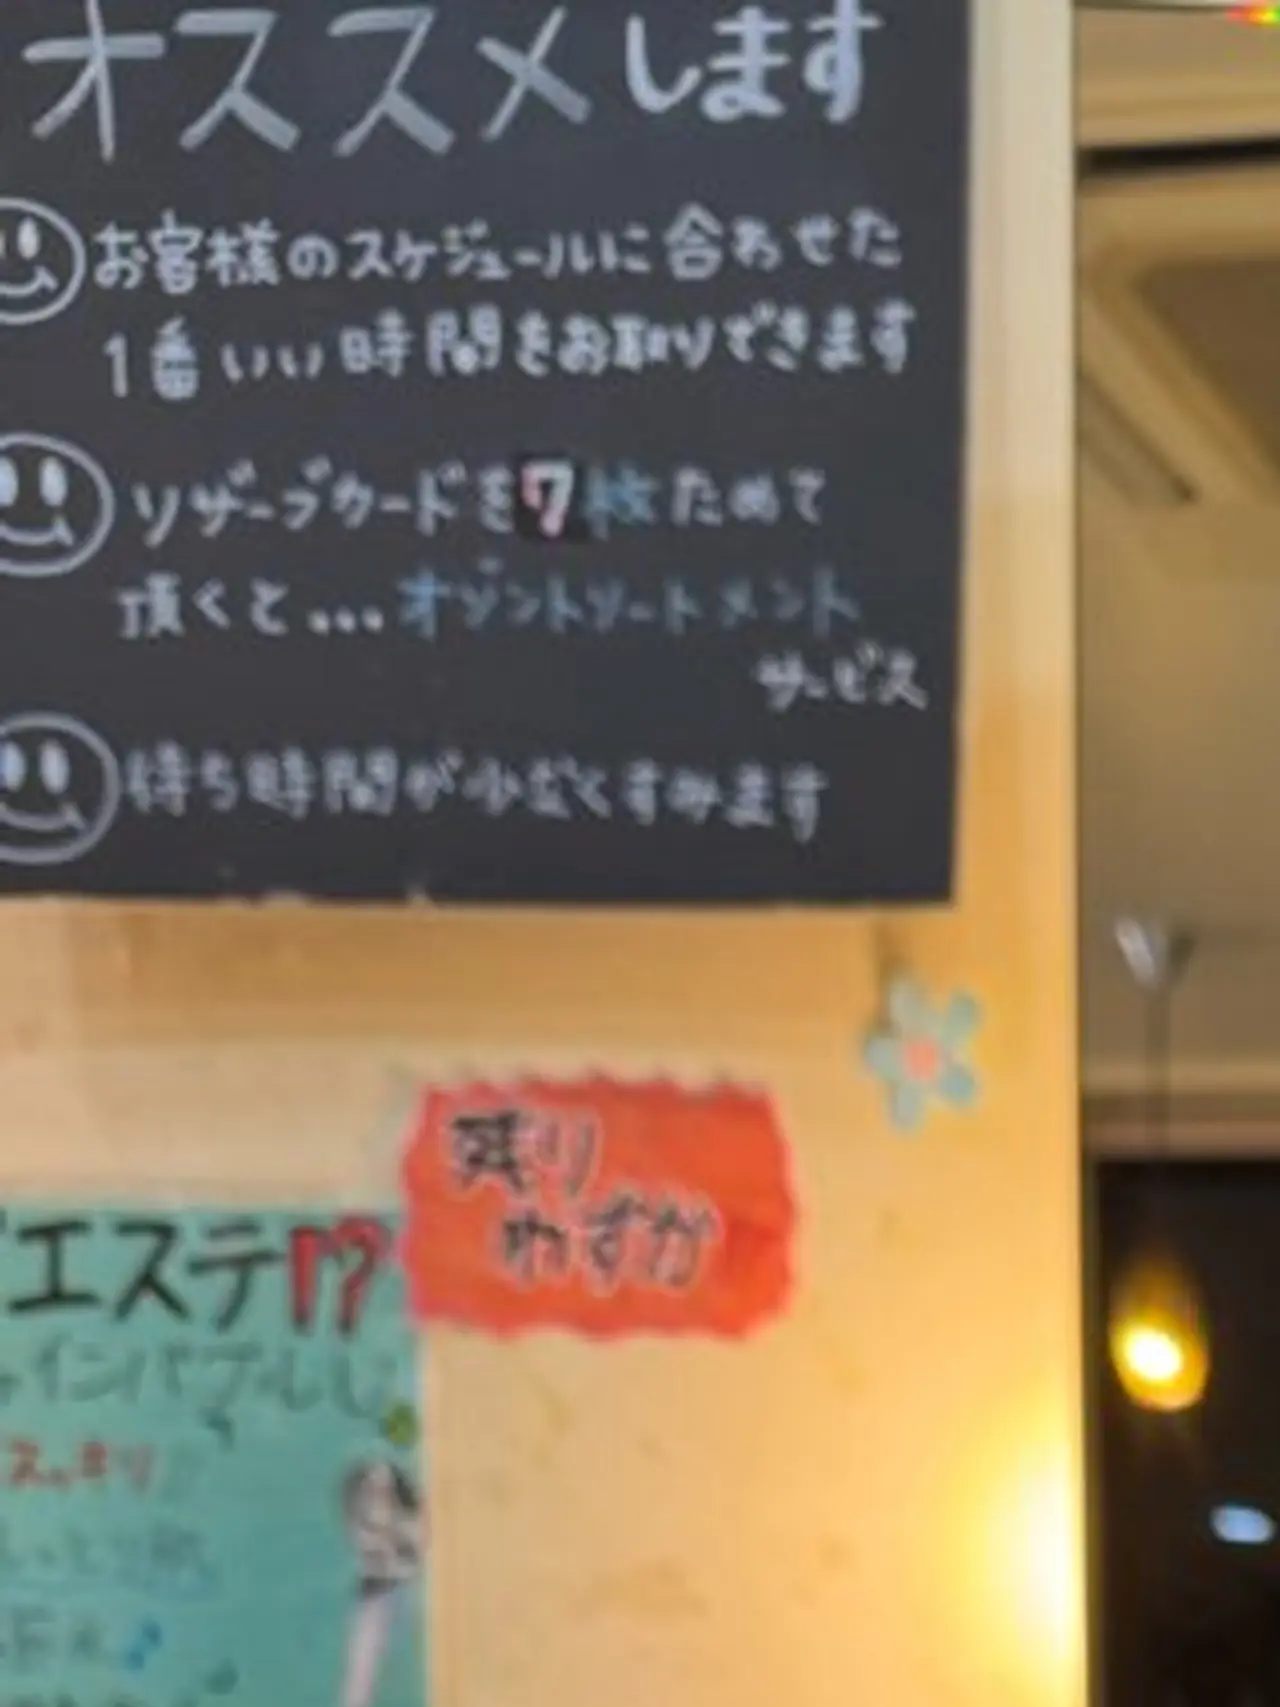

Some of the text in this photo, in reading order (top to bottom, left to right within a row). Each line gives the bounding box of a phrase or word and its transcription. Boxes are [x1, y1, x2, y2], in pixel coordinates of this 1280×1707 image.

[20, 0, 886, 164] オススメします
[92, 204, 904, 292] お客様のスケジュールに合わせた
[753, 640, 929, 712] サービス
